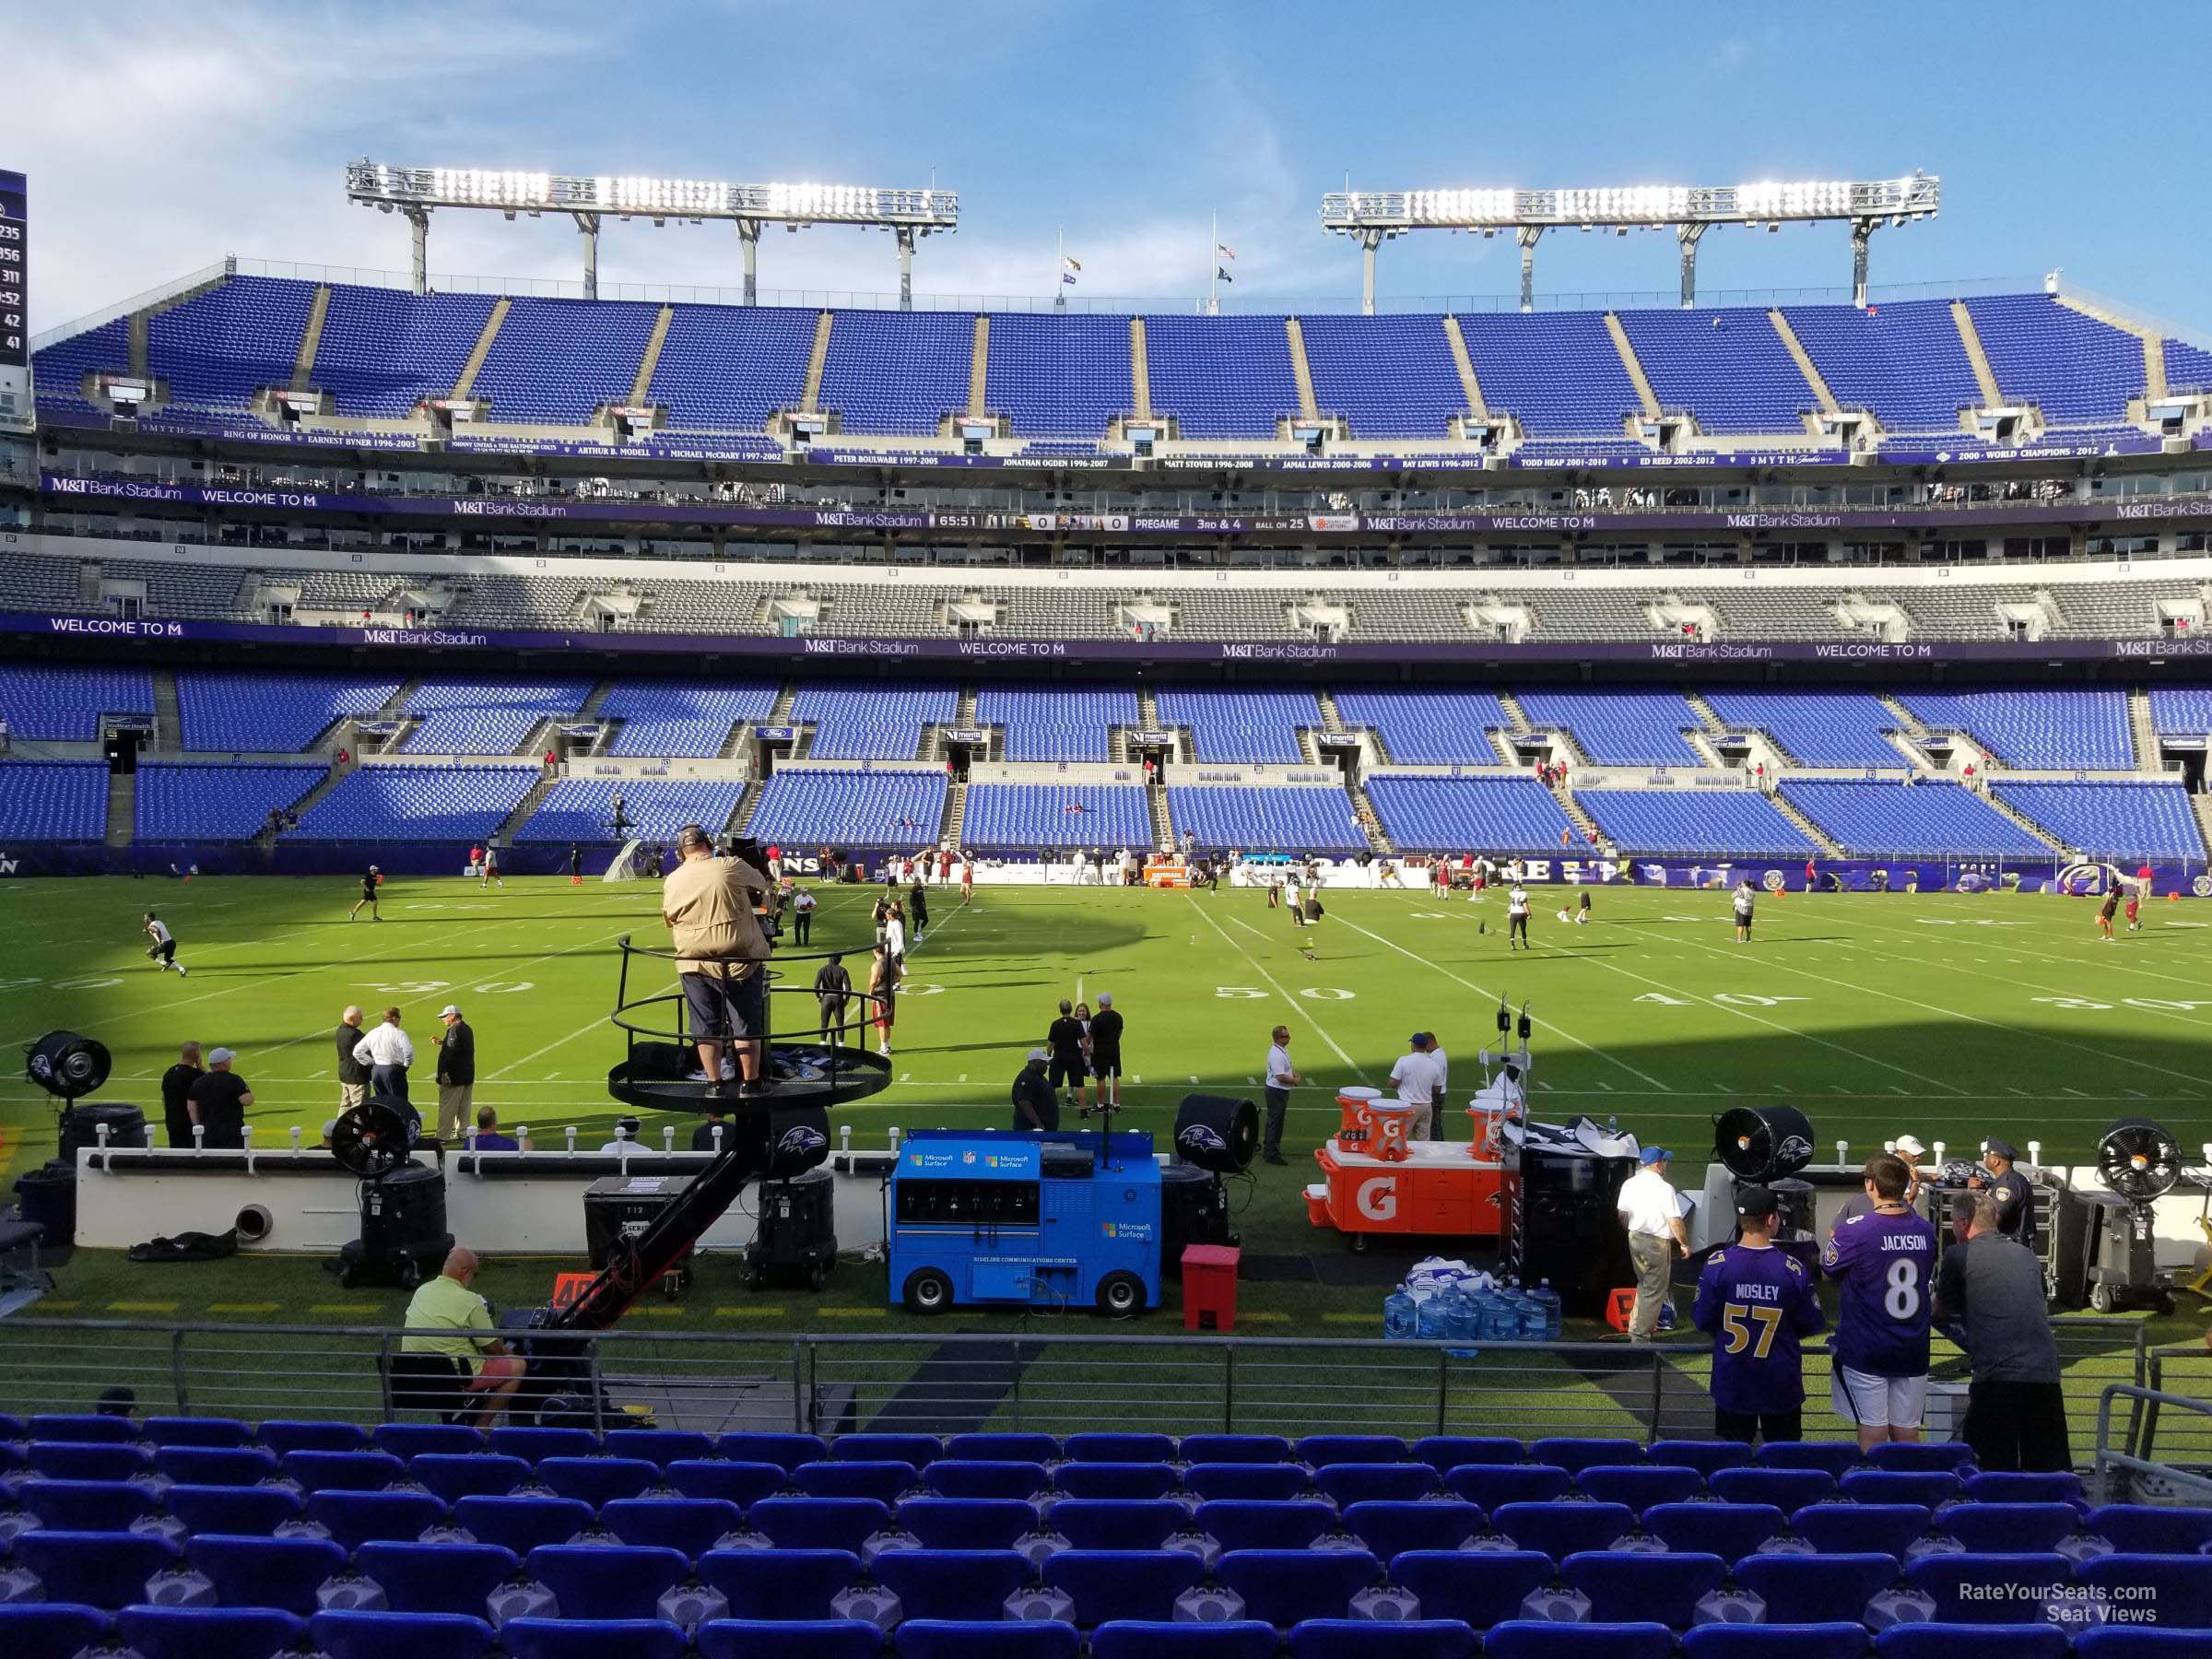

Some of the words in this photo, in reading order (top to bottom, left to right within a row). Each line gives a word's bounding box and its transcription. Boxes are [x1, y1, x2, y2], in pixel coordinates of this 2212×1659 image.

[2, 270, 20, 283] 311
[5, 314, 20, 327] 42
[6, 336, 20, 348] 41
[223, 429, 245, 440] RING
[247, 431, 259, 441] OF
[261, 433, 291, 441] HONOR
[308, 436, 344, 445] EARNEST
[346, 438, 371, 447] BYNER
[374, 439, 416, 448] 1996-2003
[578, 447, 608, 455] ARTHUR
[619, 448, 651, 456] MODELL
[670, 450, 703, 459] MICHAEL
[705, 452, 738, 460] McCRARY
[742, 452, 782, 461] 1997-2002
[1959, 452, 1980, 461] 2000
[1986, 451, 2018, 459] WORLD
[2020, 447, 2071, 458] CHAMPIONS
[2077, 446, 2099, 456] 2012
[834, 454, 856, 464] PETER
[858, 455, 898, 464] BOULWARE
[900, 456, 938, 465] 1997-2005
[1003, 458, 1041, 467] JONATHAN
[1042, 458, 1068, 467] OGDEN
[1070, 459, 1108, 468] 1996-2007
[1215, 461, 1253, 469] 1996-2008
[1282, 460, 1306, 469] JAMAL
[1308, 460, 1330, 468] LEWIS
[1332, 460, 1371, 468] 2000-2006
[1403, 460, 1417, 468] RAY
[1418, 459, 1439, 467] LEWIS
[1441, 459, 1478, 467] 1996-2012
[1545, 458, 1564, 466] HEAP
[1566, 458, 1607, 466] 2001-2010
[1640, 457, 1652, 465] ED
[1653, 456, 1673, 465] REED
[1674, 456, 1714, 465] 2002-2012
[52, 477, 89, 493] M&T
[90, 480, 124, 496] Bank
[125, 483, 182, 500] Stadium
[202, 489, 276, 505] WELCOME
[280, 494, 300, 506] TO
[454, 500, 486, 514] M&T
[487, 503, 516, 516] Bank
[517, 503, 566, 517] Stadium
[2116, 504, 2151, 518] M&T
[2153, 504, 2187, 516] Bank
[816, 512, 844, 525] M&T
[846, 513, 874, 526] Bank
[876, 514, 923, 527] Stadium
[939, 515, 976, 526] 65:51
[1038, 517, 1047, 528] 0
[1112, 518, 1122, 529] 0
[1135, 519, 1179, 530] PREGAME
[1196, 519, 1217, 530] 3RD
[1219, 519, 1230, 530] &
[1232, 520, 1241, 529] 4
[1289, 519, 1303, 529] 25
[1367, 517, 1396, 530] M&T
[1397, 518, 1426, 530] Bank
[1427, 517, 1475, 530] Stadium
[1492, 518, 1557, 528] WELCOME
[1560, 517, 1579, 528] TO
[1727, 514, 1758, 527] M&T
[1759, 514, 1790, 527] Bank
[1791, 512, 1840, 526] Stadium
[52, 618, 135, 634] WELCOME
[140, 622, 163, 635] TO
[364, 629, 398, 643] M&T
[399, 631, 432, 643] Bank
[433, 630, 486, 645] Stadium
[805, 639, 837, 653] M&T
[838, 641, 869, 653] Bank
[870, 641, 918, 653] Stadium
[959, 642, 1026, 653] WELCOME
[1030, 643, 1049, 654] TO
[1222, 644, 1254, 657] M&T
[1255, 645, 1286, 657] Bank
[1287, 644, 1335, 657] Stadium
[1652, 644, 1685, 657] M&T
[1686, 645, 1718, 657] Bank
[1720, 645, 1771, 657] Stadium
[1816, 645, 1888, 656] WELCOME
[1893, 645, 1914, 656] TO
[2115, 641, 2154, 655] M&T
[2156, 641, 2192, 654] Bank
[959, 730, 981, 738] merritt
[2162, 739, 2205, 747] Southwest
[1215, 986, 1356, 1000] 50
[1383, 1119, 1399, 1137] G
[1357, 1176, 1396, 1221] G
[1881, 1235, 1926, 1251] JACKSON
[1735, 1283, 1780, 1301] MOSLEY
[1885, 1258, 1920, 1320] 8
[1724, 1303, 1783, 1359] 57
